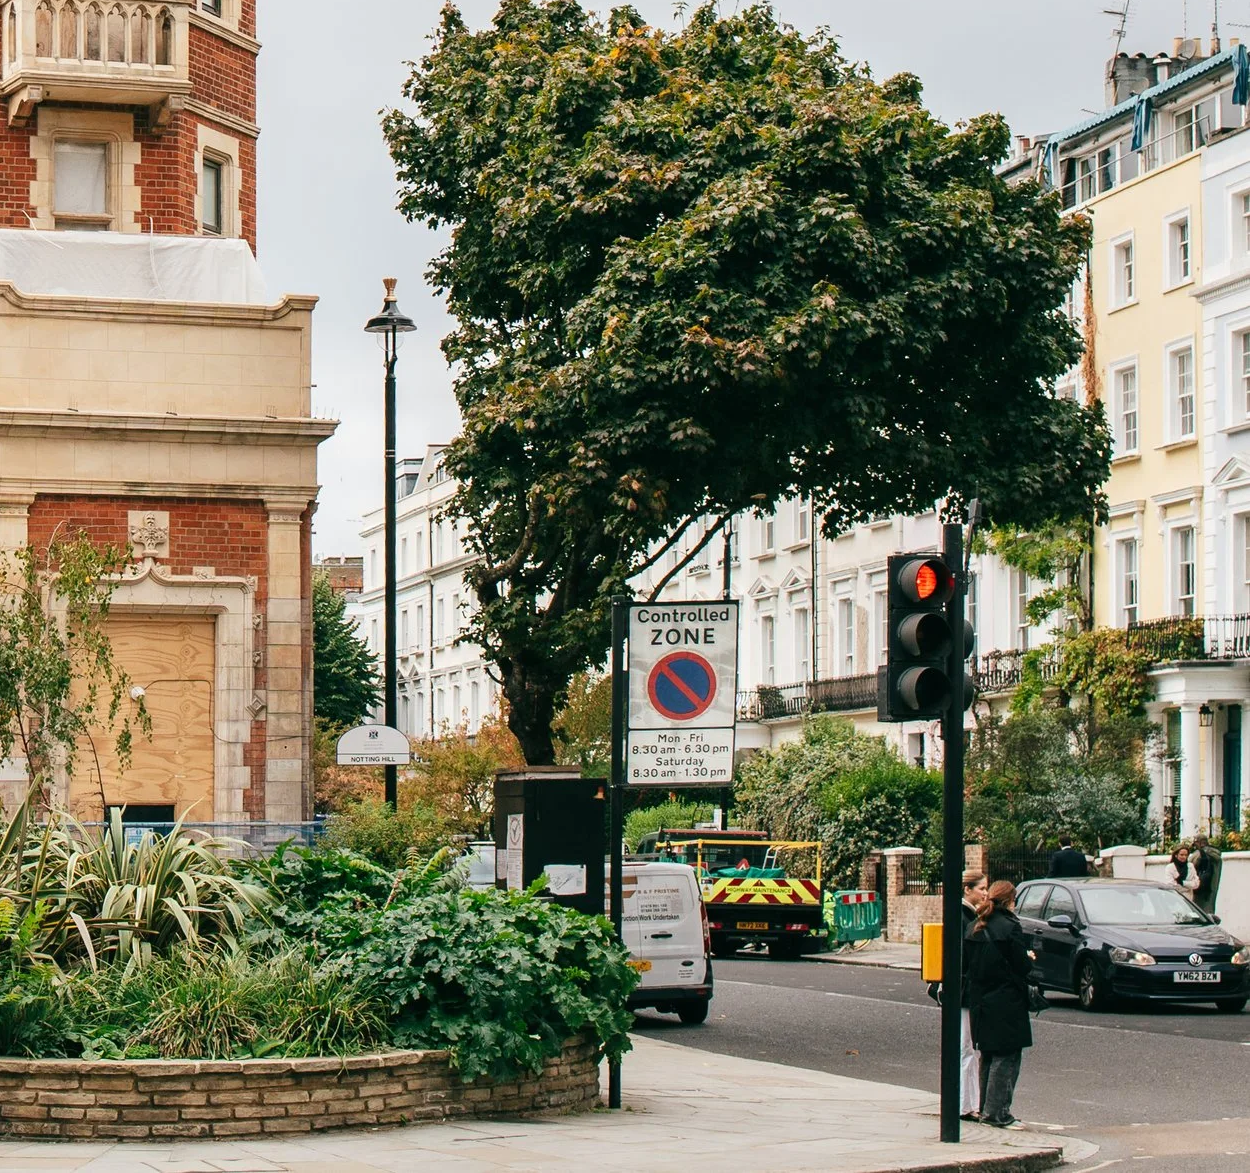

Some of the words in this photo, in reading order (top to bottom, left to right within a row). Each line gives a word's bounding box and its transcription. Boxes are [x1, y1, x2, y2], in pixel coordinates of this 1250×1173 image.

[637, 608, 729, 623] Controlled
[651, 628, 715, 645] ZONE
[658, 734, 680, 743] Mon
[690, 733, 703, 742] Fri
[632, 745, 658, 754] 8.30
[684, 744, 710, 753] 6.30
[712, 746, 729, 754] pm
[656, 757, 704, 766] Saturday
[633, 768, 658, 777] 8.30
[685, 768, 707, 777] 1.30
[710, 769, 726, 777] pm
